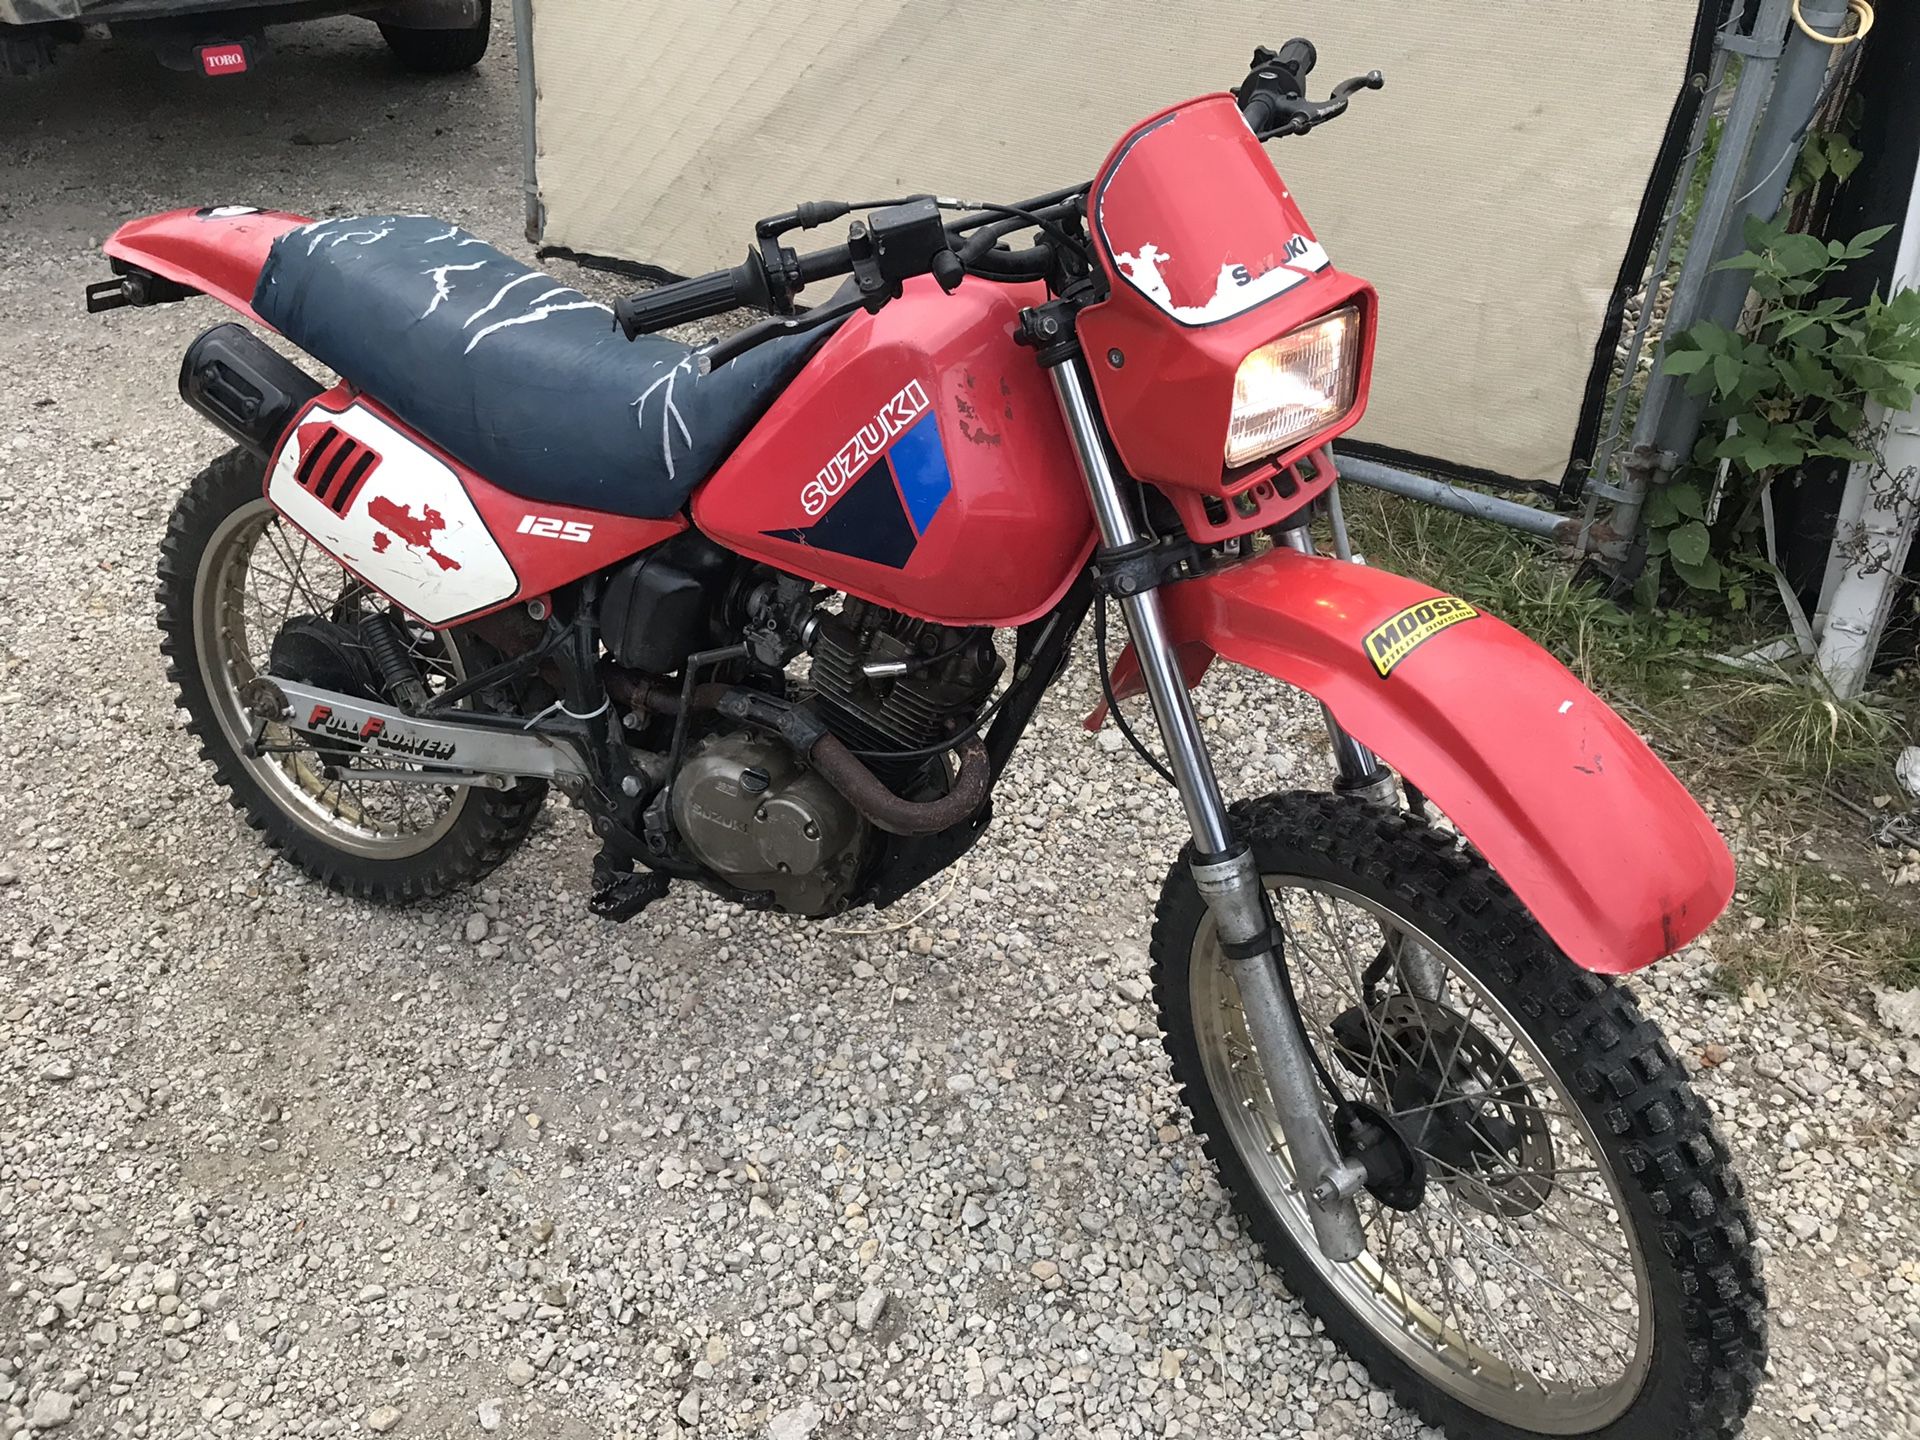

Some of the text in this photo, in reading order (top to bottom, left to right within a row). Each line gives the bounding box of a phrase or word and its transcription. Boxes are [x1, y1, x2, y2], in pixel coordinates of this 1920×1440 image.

[206, 53, 243, 67] TORO
[801, 379, 930, 516] SUZUKI
[516, 515, 594, 543] 125
[1372, 599, 1467, 659] MOOSE
[1382, 611, 1474, 669] UTILITY DIVISION
[691, 802, 749, 835] SUZUKI
